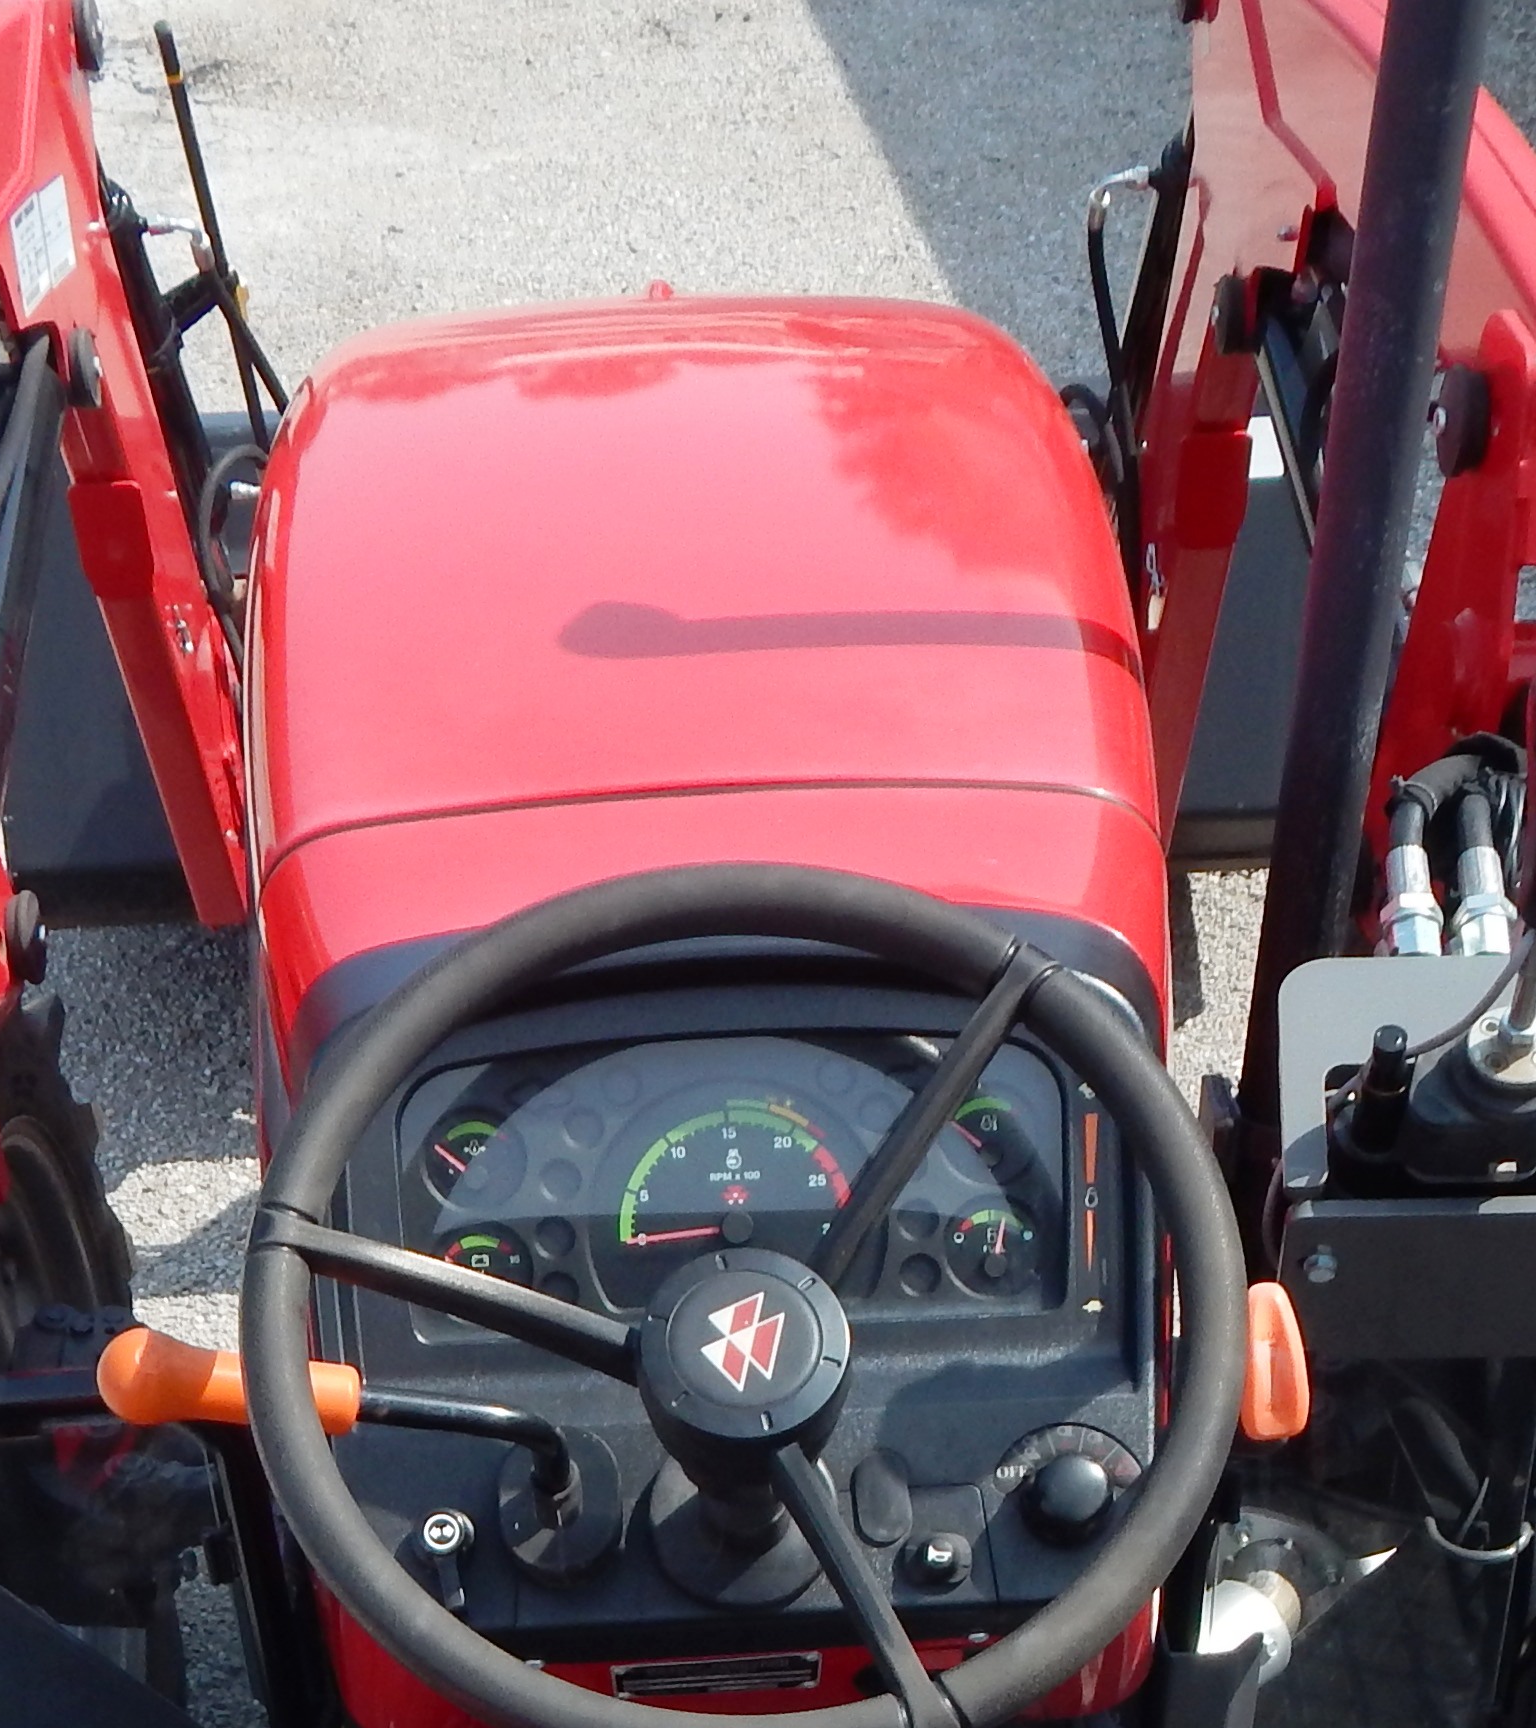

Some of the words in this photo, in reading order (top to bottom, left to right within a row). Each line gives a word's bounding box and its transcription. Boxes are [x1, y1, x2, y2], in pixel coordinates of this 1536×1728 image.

[722, 1128, 737, 1139] 15
[774, 1137, 792, 1148] 20
[671, 1147, 686, 1158] 10
[709, 1172, 733, 1182] RPM
[744, 1170, 761, 1180] 100
[809, 1175, 827, 1187] 25
[640, 1190, 649, 1202] 5
[996, 1465, 1027, 1479] OFF
